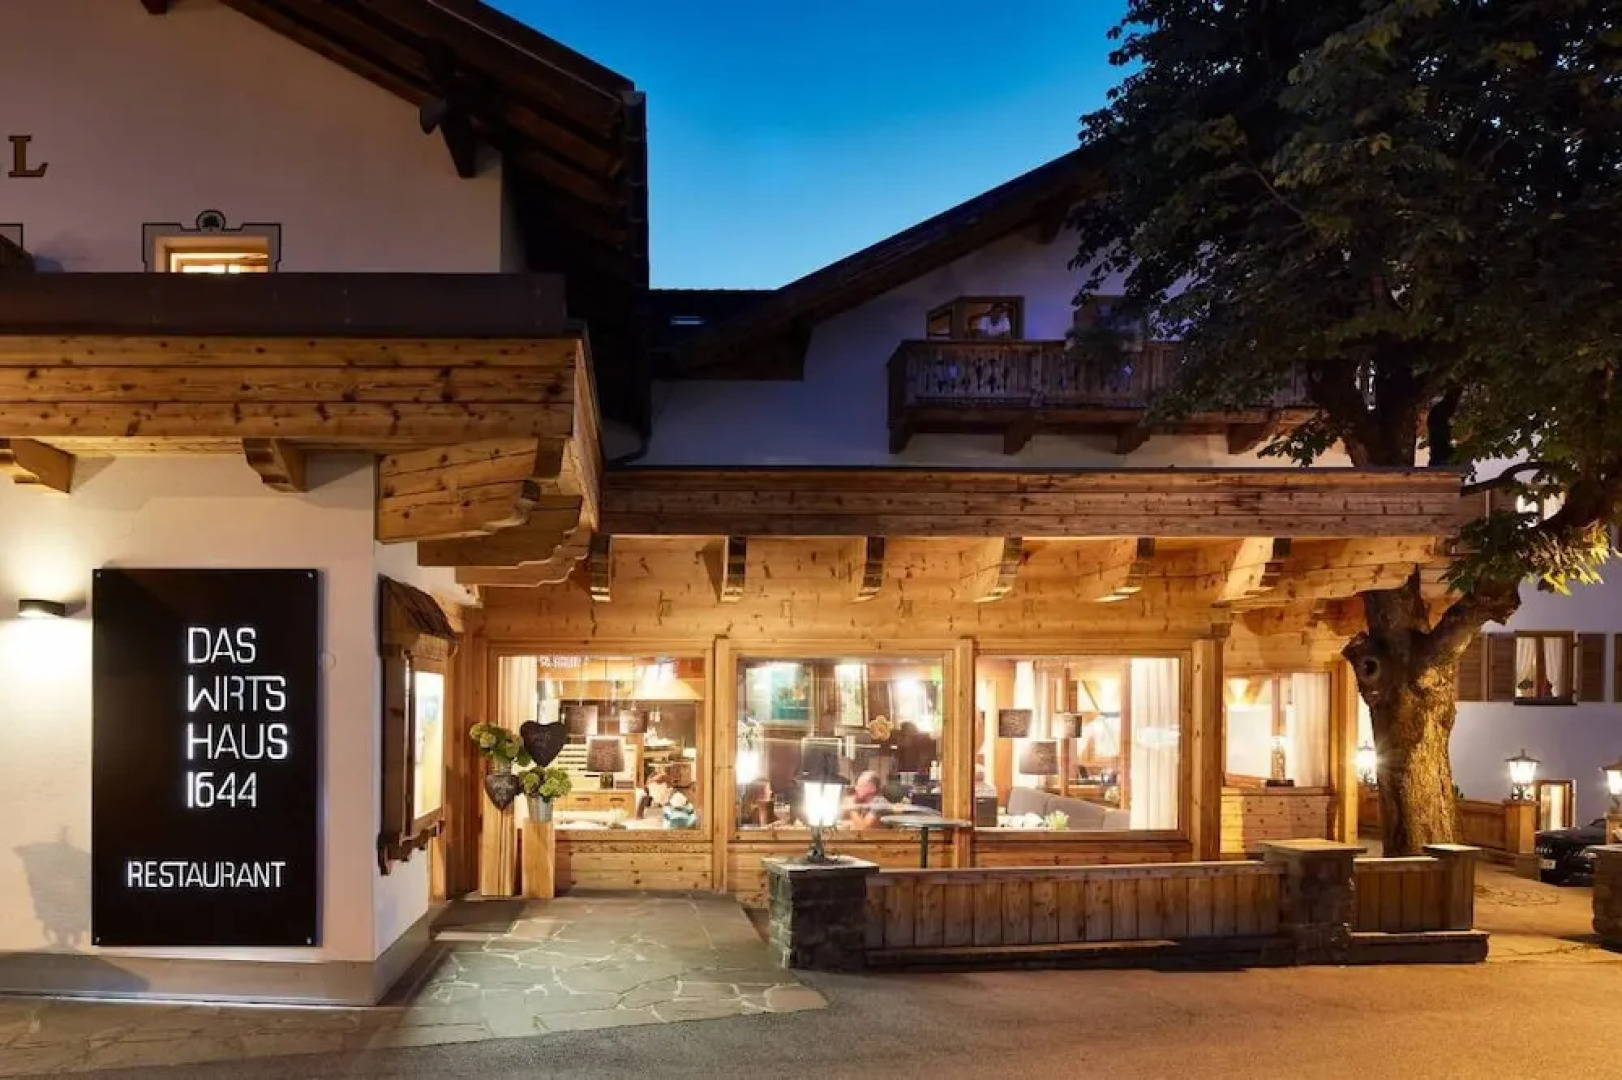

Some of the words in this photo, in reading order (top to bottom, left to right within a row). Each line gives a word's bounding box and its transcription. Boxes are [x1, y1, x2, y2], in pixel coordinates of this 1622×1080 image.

[187, 627, 256, 664] DAS
[187, 675, 286, 712] WIRTS
[187, 723, 288, 760] HAUS
[187, 771, 256, 808] 1644
[127, 860, 286, 888] RESTAURANT
